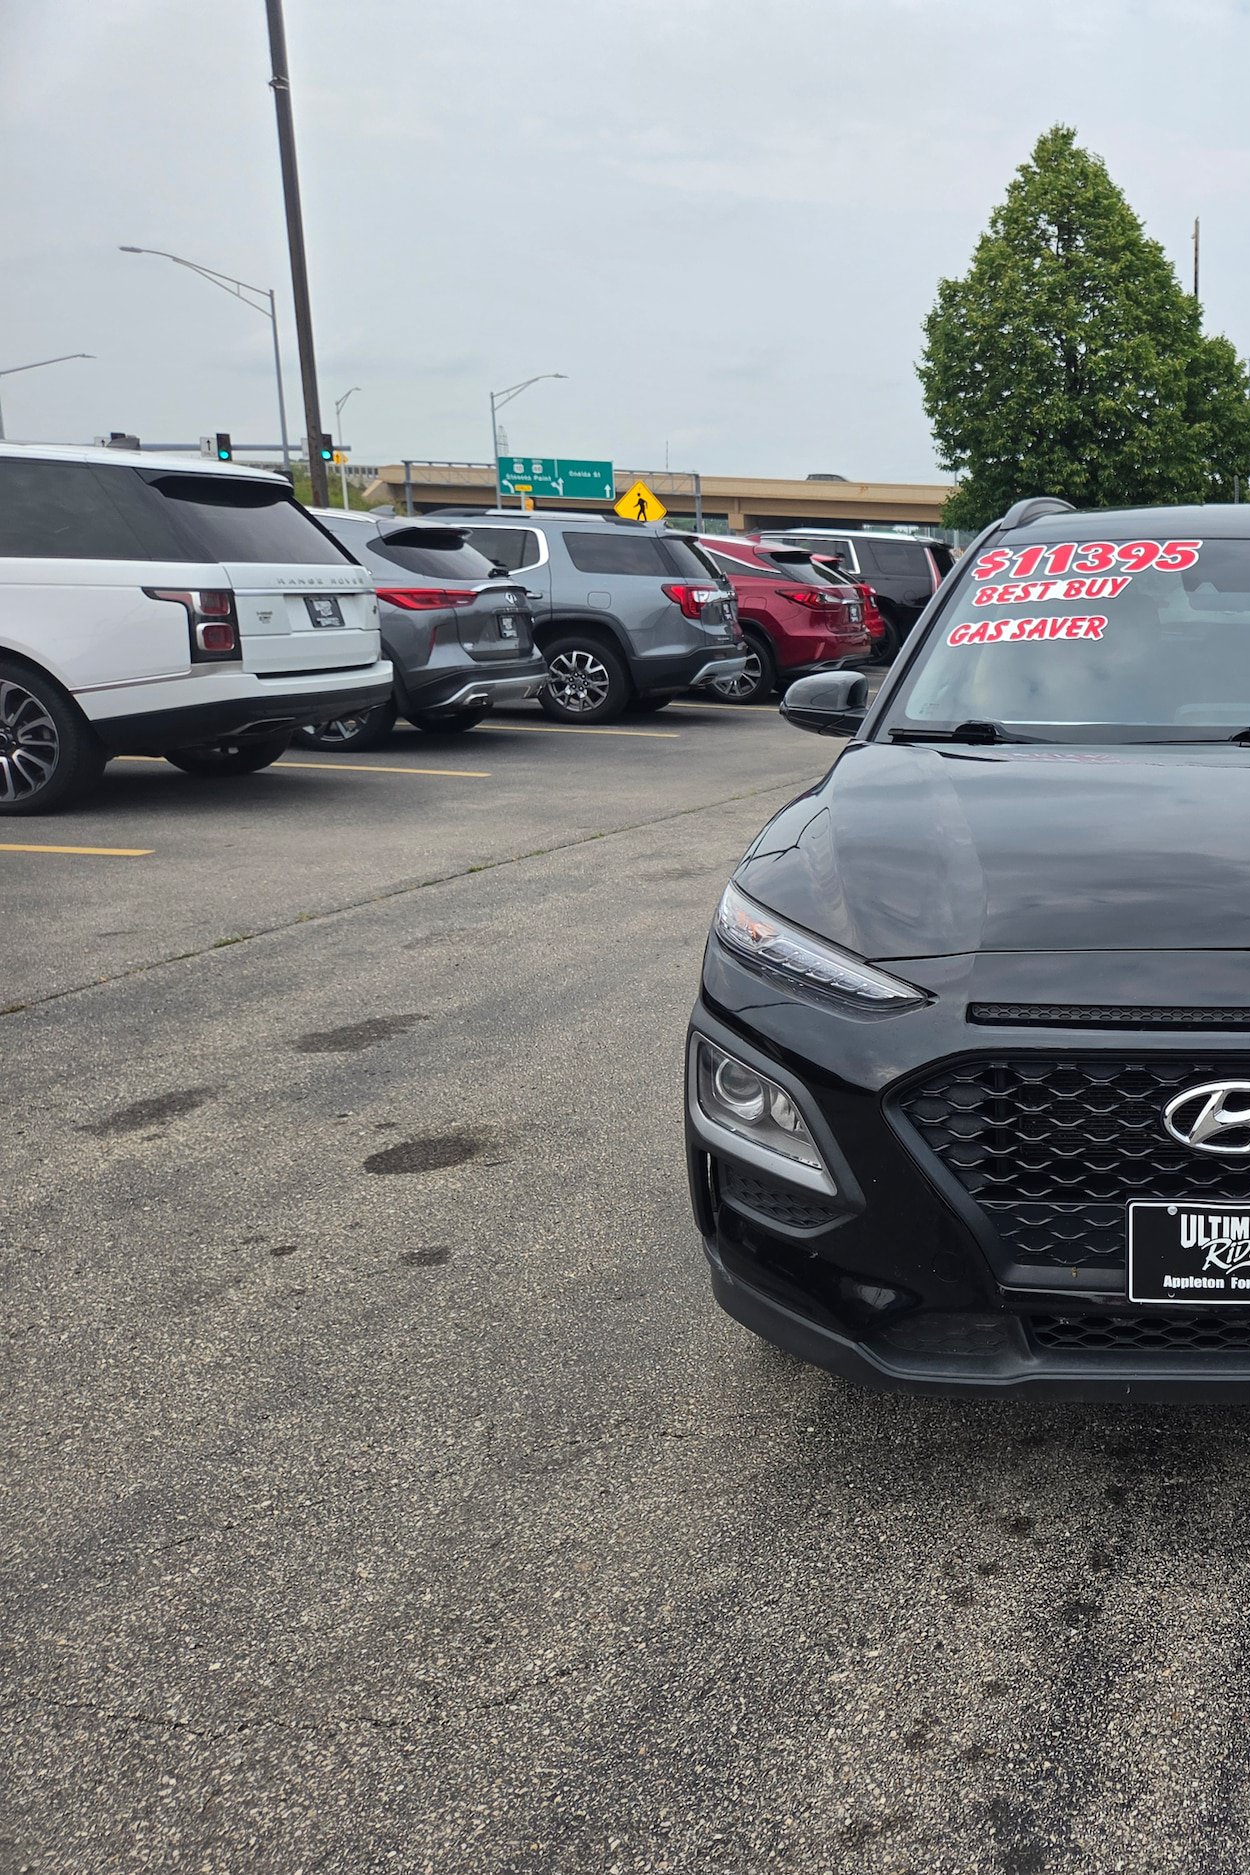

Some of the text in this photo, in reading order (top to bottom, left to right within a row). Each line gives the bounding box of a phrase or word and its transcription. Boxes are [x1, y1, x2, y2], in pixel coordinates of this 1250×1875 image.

[972, 541, 1202, 580] $11395
[276, 577, 364, 585] RANGE ROVER
[974, 577, 1131, 605] BEST BUY
[948, 616, 1107, 646] GAS SAVER
[1163, 1275, 1225, 1290] Appleton
